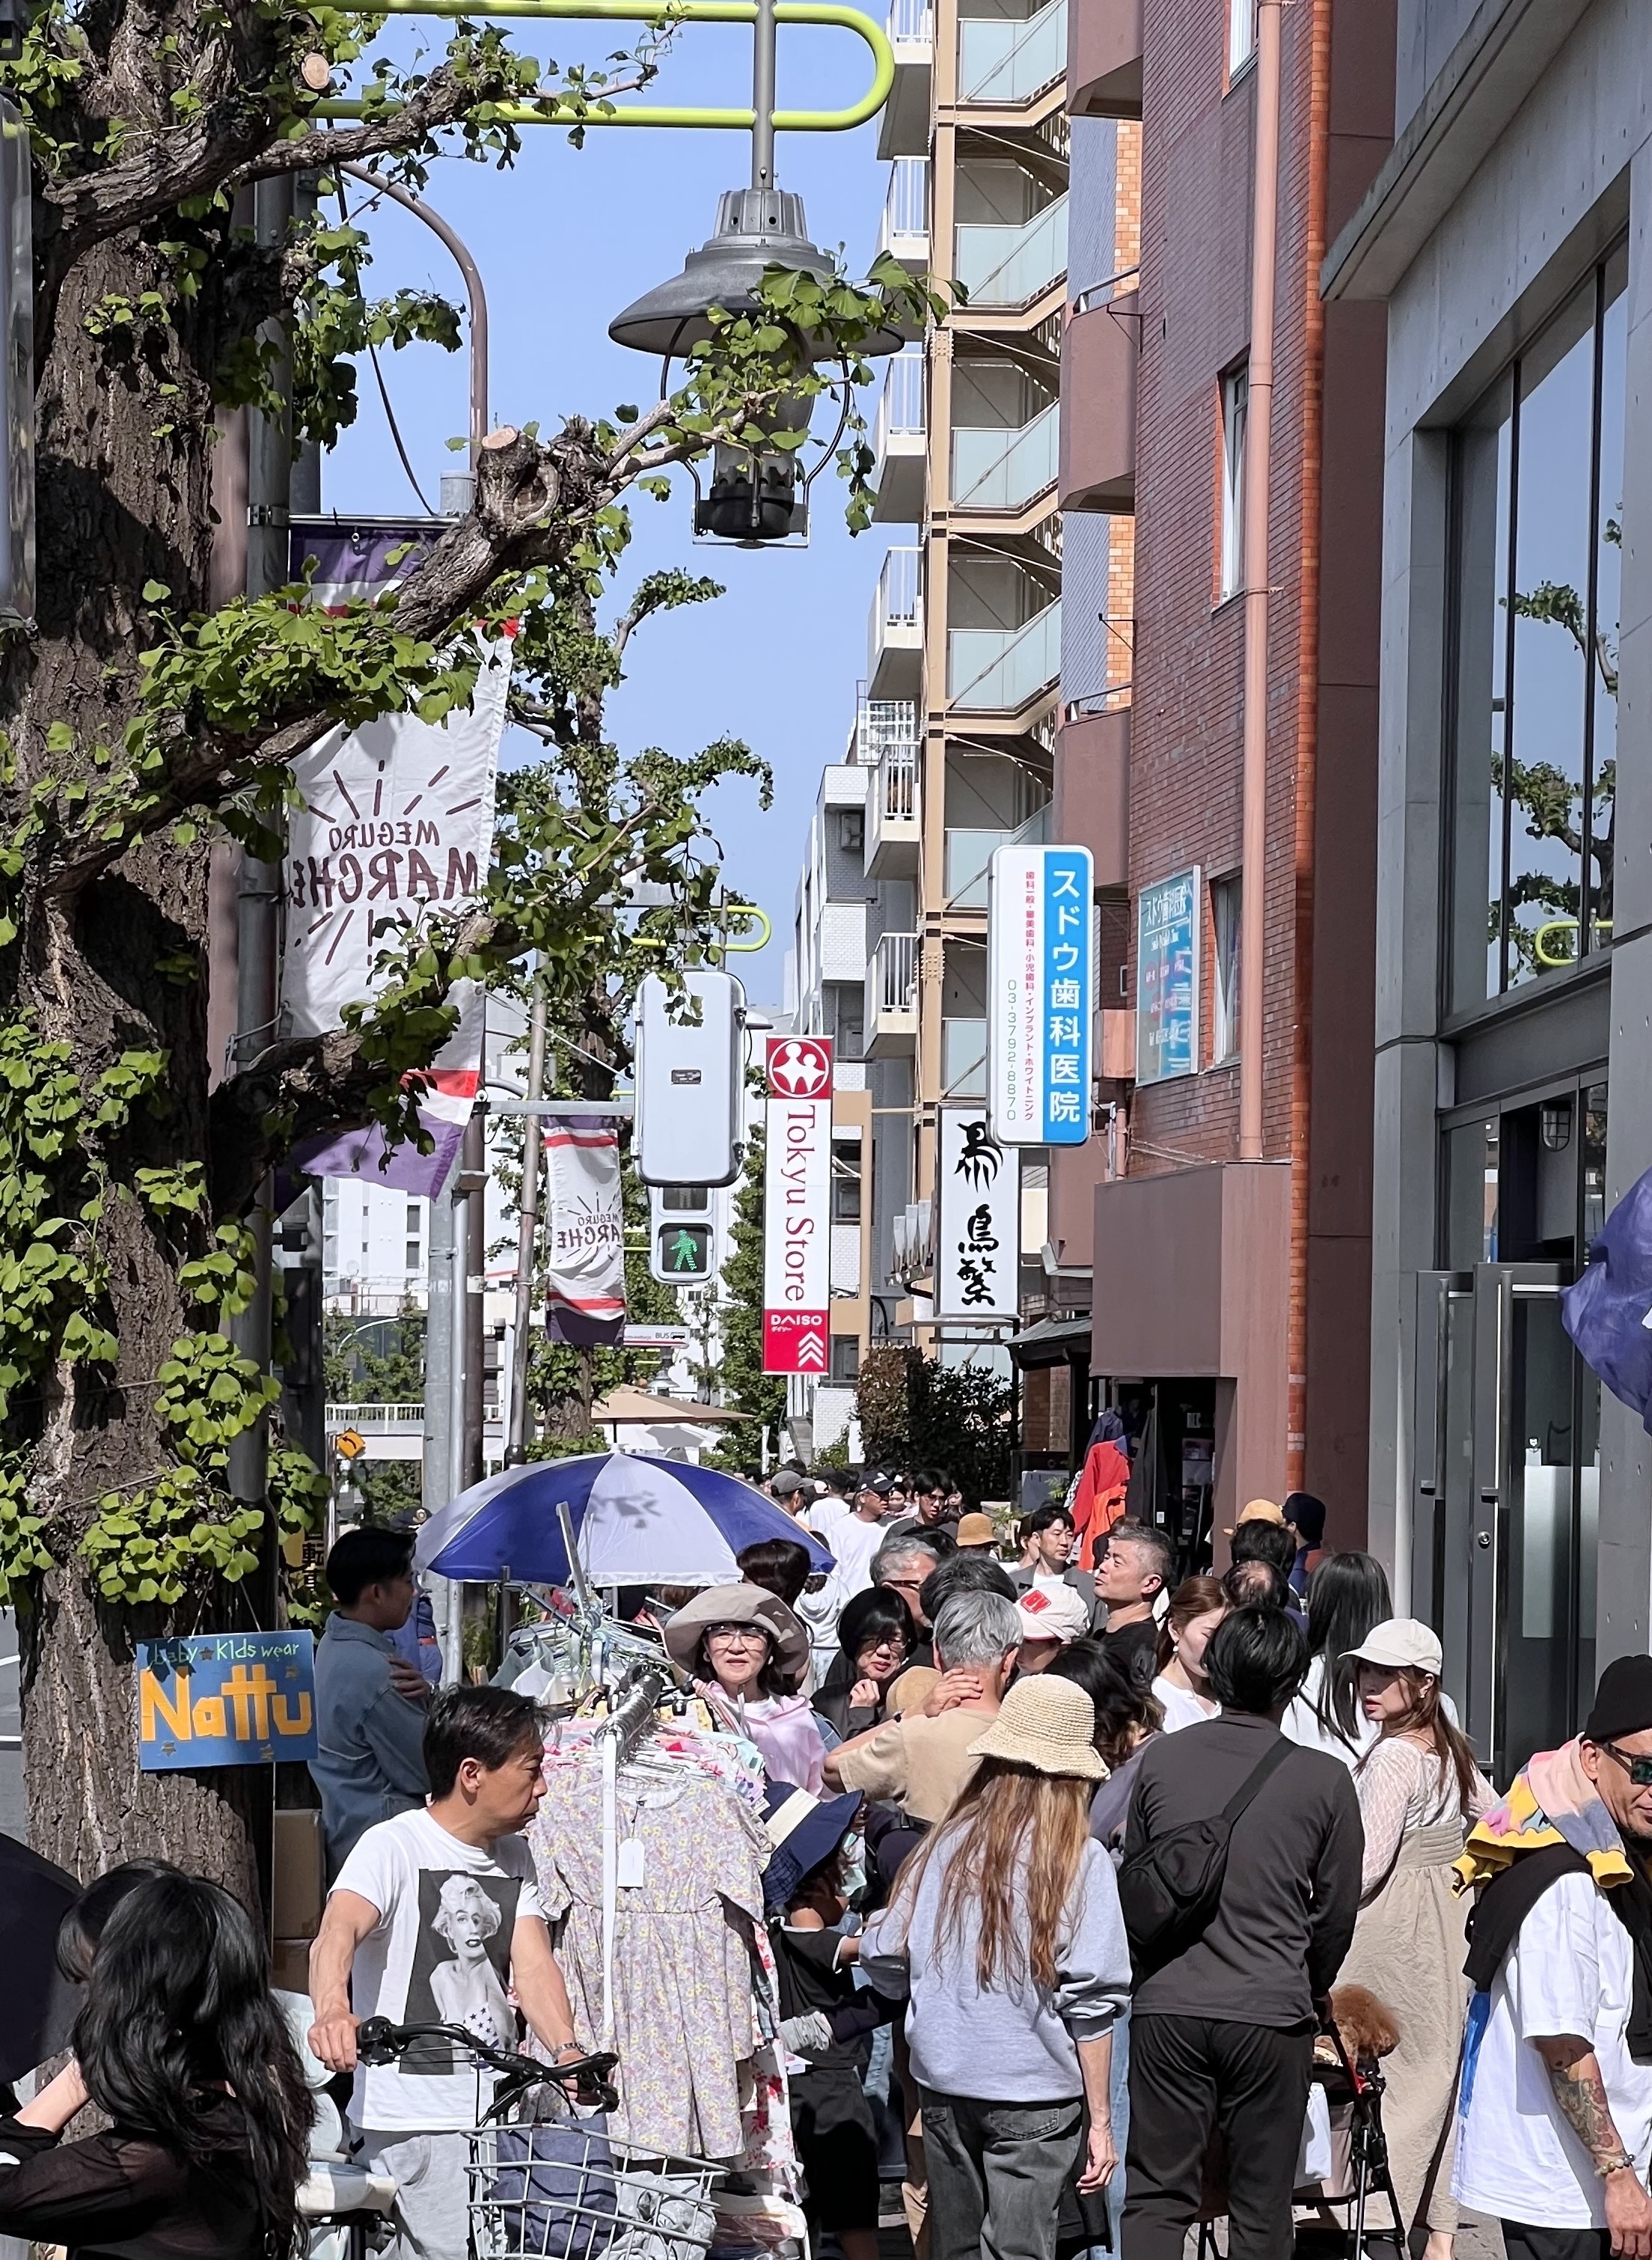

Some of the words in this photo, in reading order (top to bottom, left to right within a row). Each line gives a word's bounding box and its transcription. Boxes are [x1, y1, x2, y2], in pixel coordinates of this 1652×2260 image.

[1050, 870, 1082, 1123] スドウ歯科医院
[1006, 979, 1017, 1121] 03-3792-8870
[781, 1105, 816, 1205] Tokyu
[785, 1216, 815, 1301] Store
[771, 1314, 822, 1326] DAISO
[154, 1643, 198, 1665] baby
[261, 1643, 299, 1657] wear
[139, 1664, 313, 1742] Nattu
